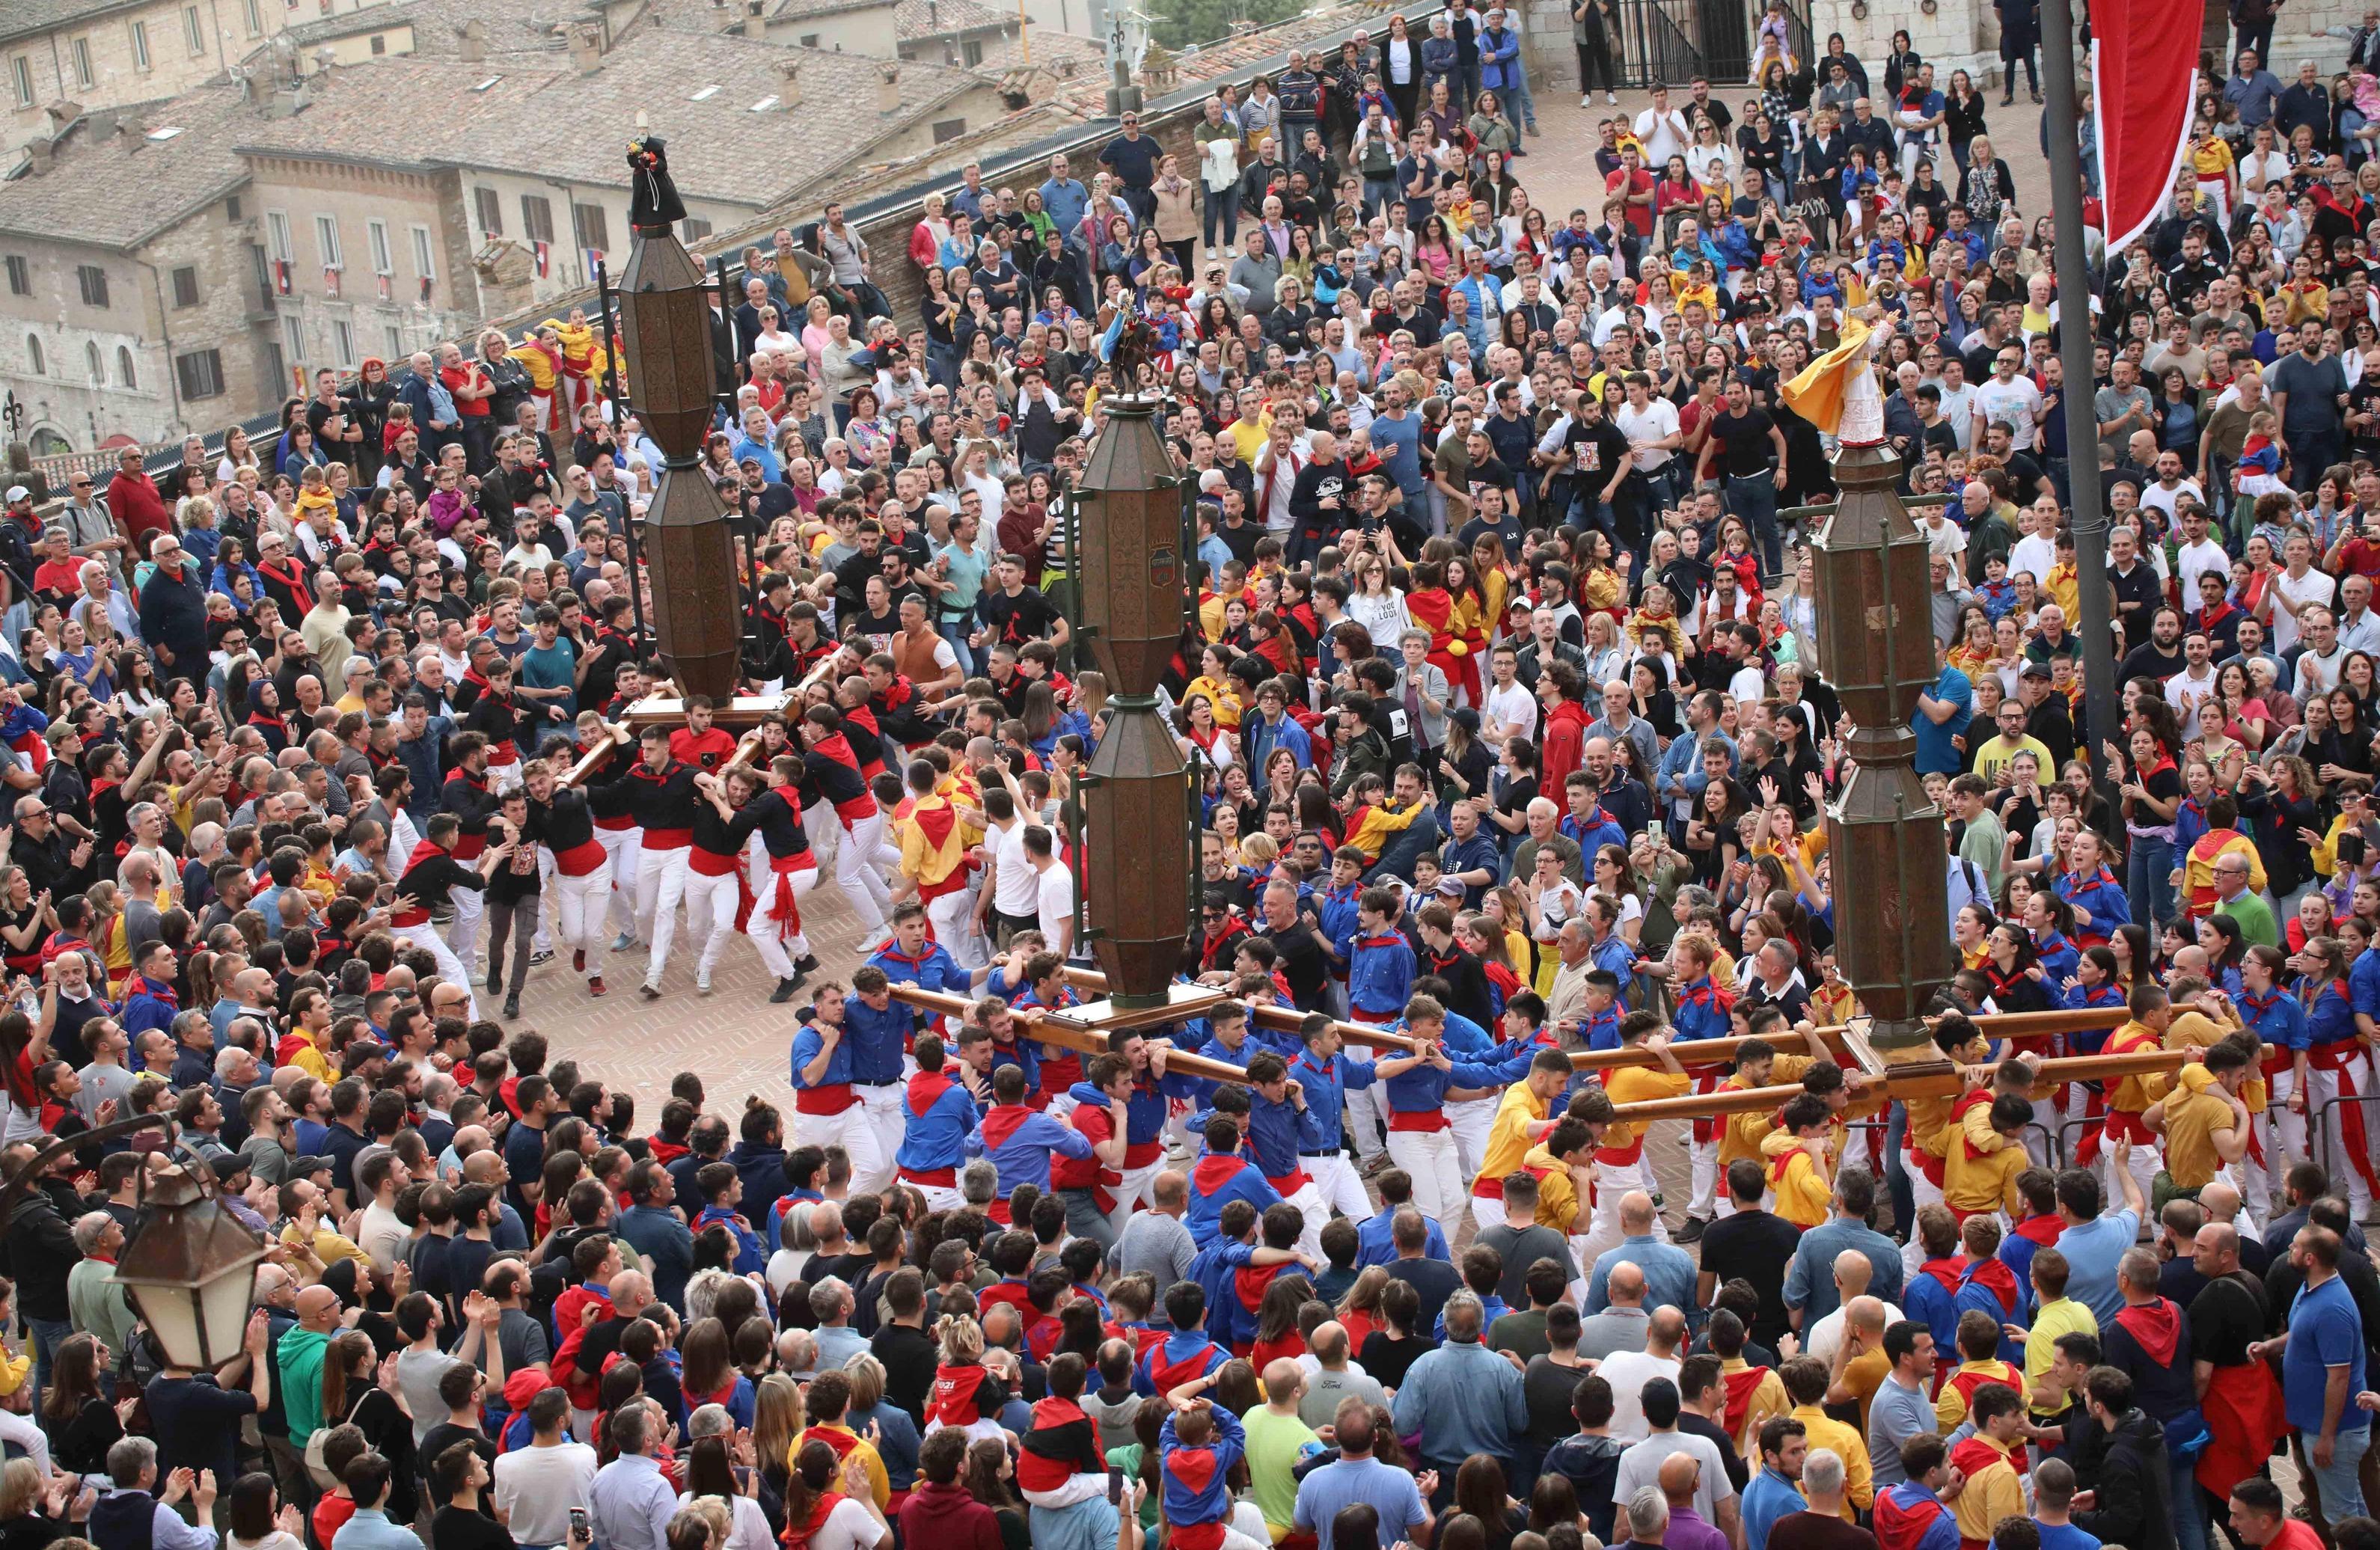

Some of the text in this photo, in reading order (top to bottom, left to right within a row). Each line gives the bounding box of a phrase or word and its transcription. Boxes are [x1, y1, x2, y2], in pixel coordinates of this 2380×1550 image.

[1381, 601, 1395, 612] YOU
[1378, 609, 1397, 620] LOOK
[1321, 1380, 1342, 1389] Ford
